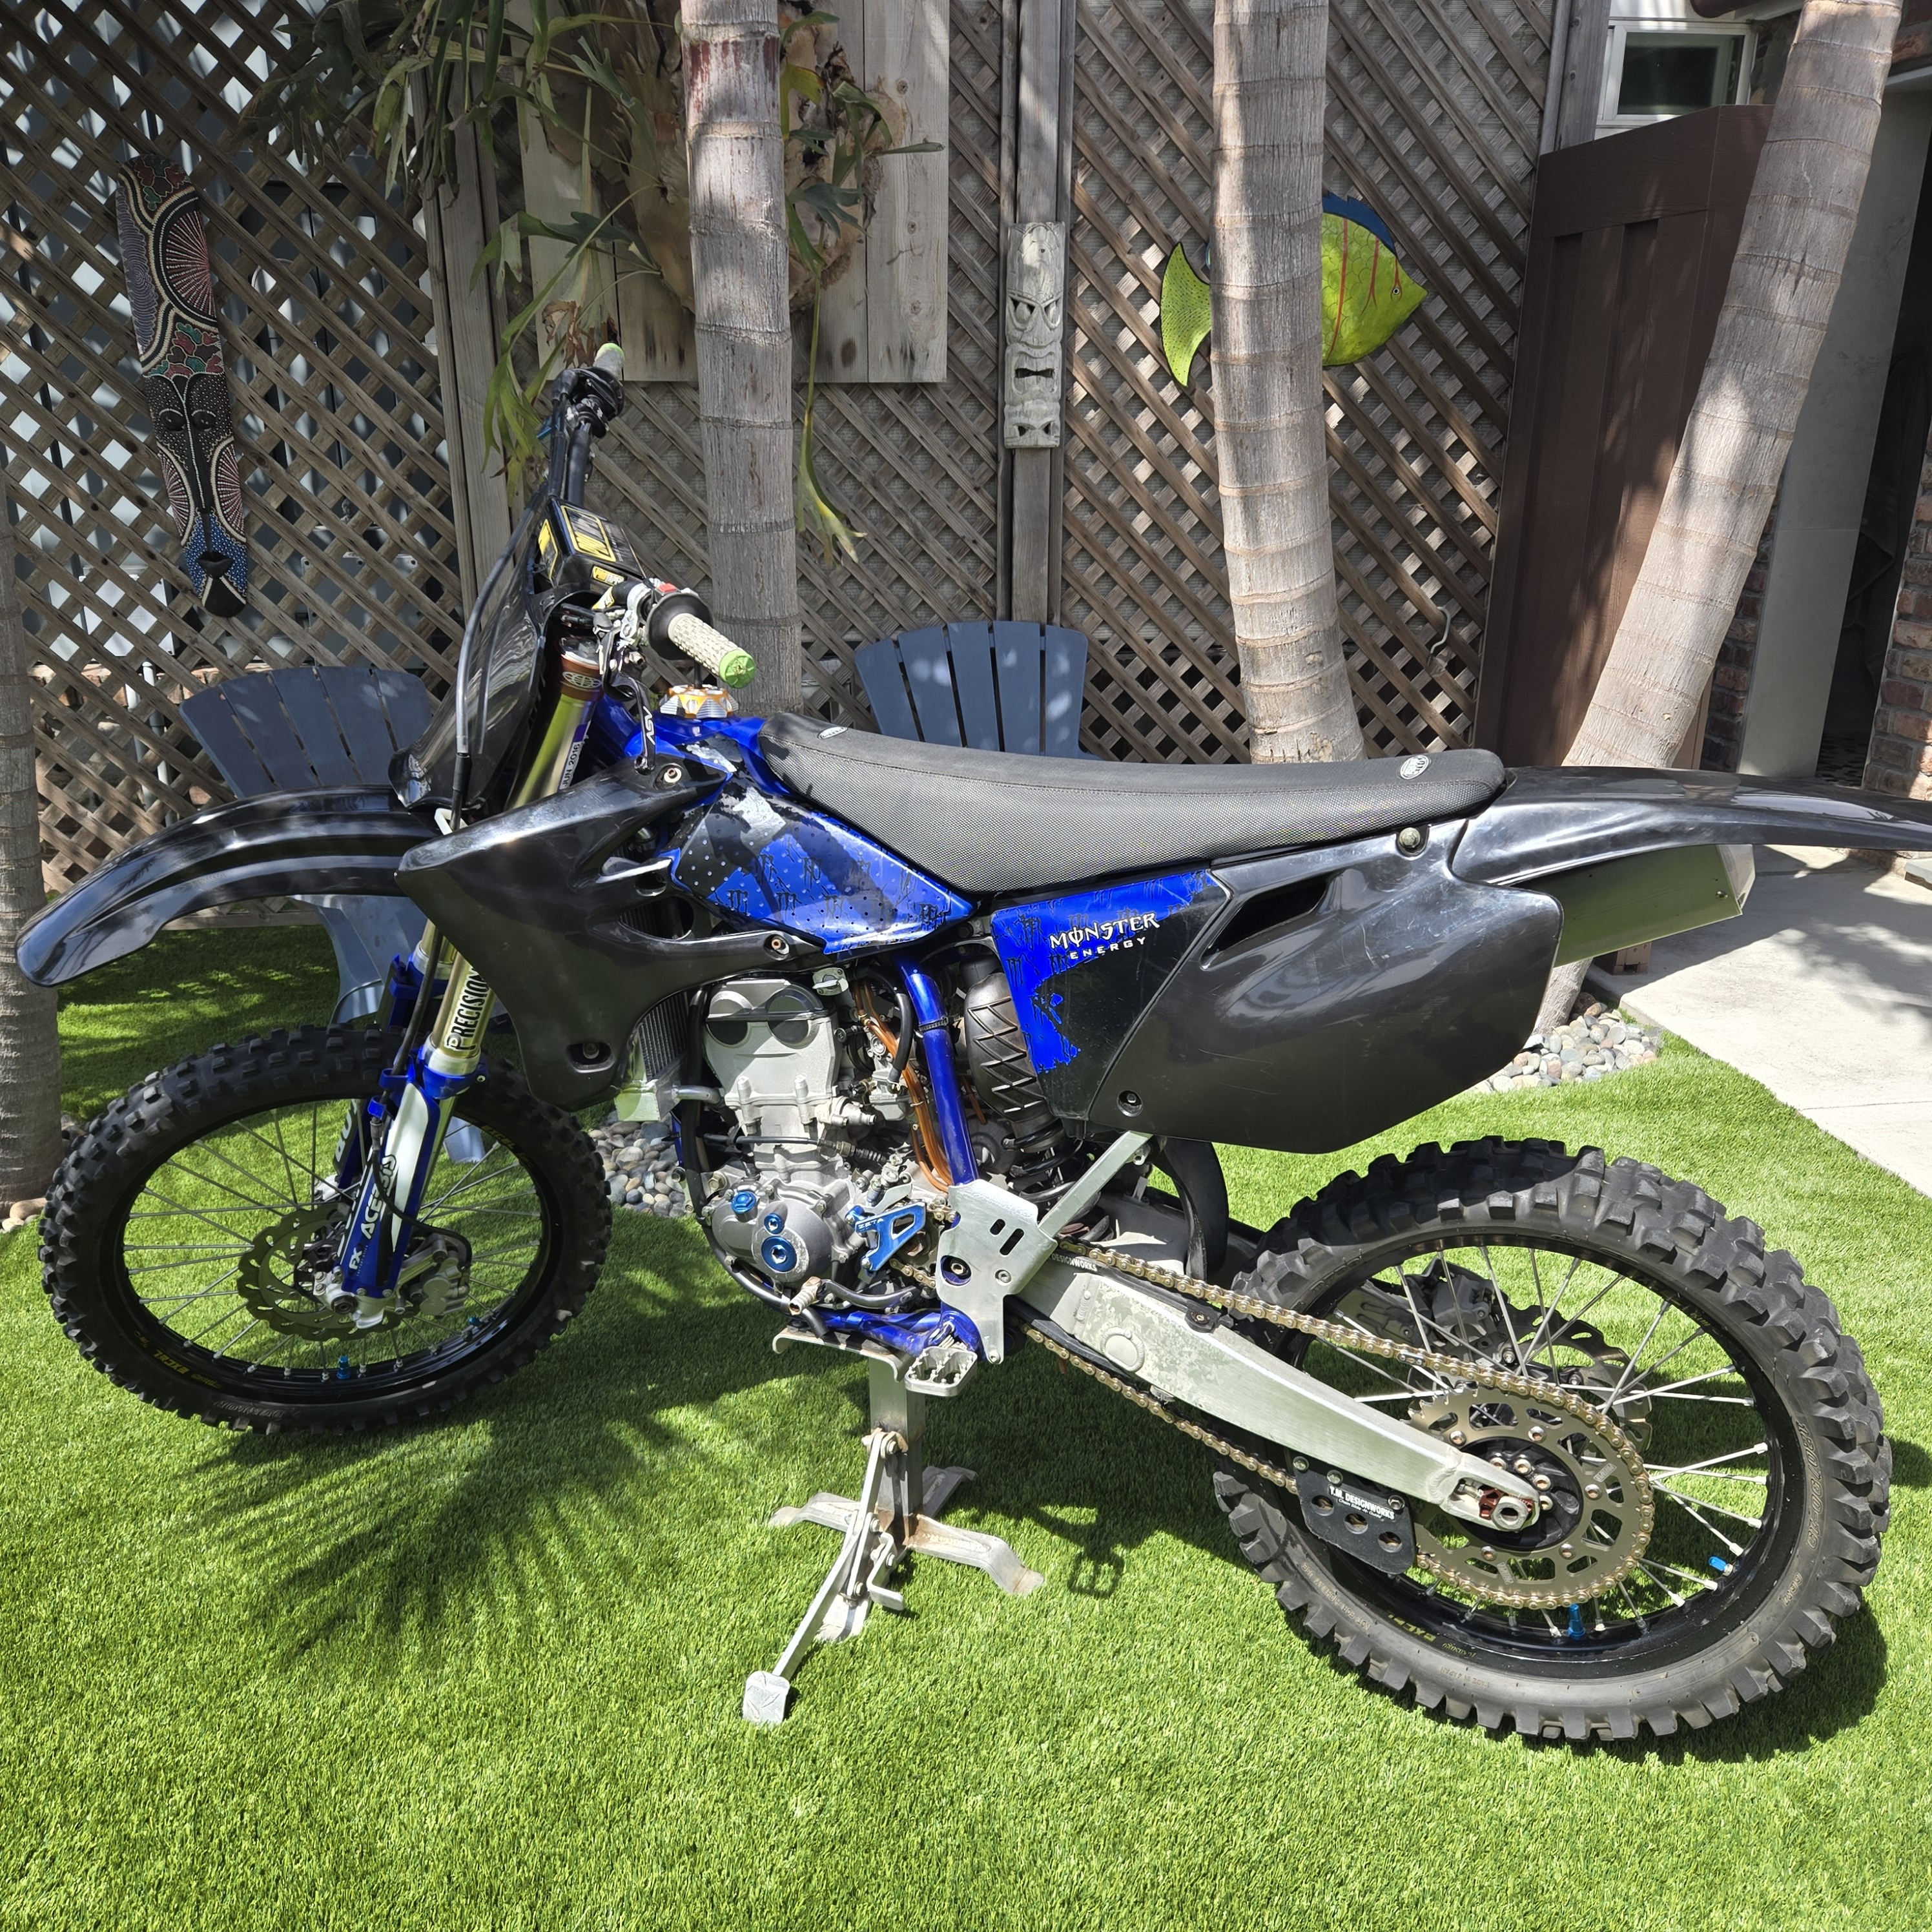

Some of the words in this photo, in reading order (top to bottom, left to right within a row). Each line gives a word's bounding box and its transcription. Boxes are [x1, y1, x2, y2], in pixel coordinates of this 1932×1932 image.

[643, 706, 655, 745] ASV
[562, 769, 572, 786] JUN
[568, 744, 581, 765] 2016
[1049, 912, 1160, 950] MONSTER
[1070, 936, 1146, 960] ENERGY
[858, 1218, 884, 1229] ZETA
[349, 1247, 363, 1270] FX
[1051, 1251, 1097, 1271] DESIGNWORKS
[1345, 1492, 1395, 1520] DESIGNWORKS
[1300, 1562, 1315, 1578] USE
[1313, 1578, 1341, 1606] HIGHWAY
[1341, 1604, 1357, 1619] FOR
[1355, 1618, 1371, 1630] NOT
[1439, 1665, 1462, 1680] JAPAN
